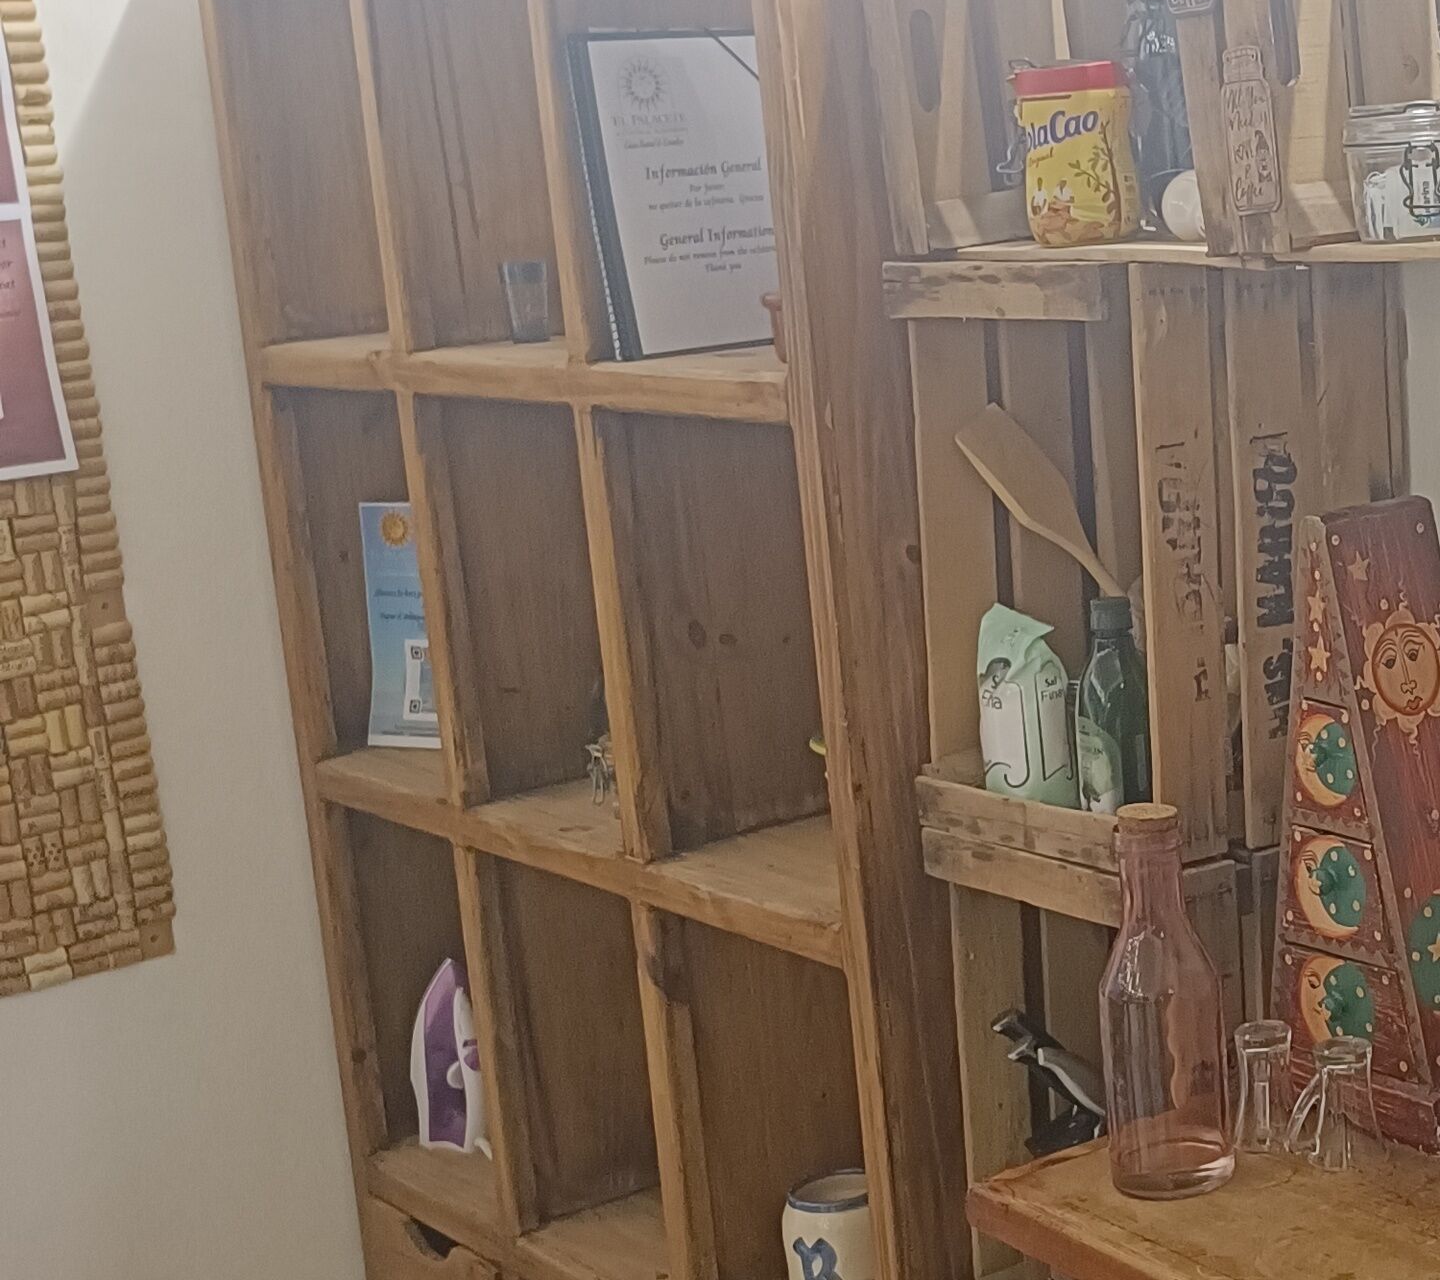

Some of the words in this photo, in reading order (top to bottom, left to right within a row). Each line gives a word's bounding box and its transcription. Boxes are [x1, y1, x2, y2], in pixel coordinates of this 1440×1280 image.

[645, 162, 717, 185] Información
[720, 156, 762, 178] General
[1235, 176, 1264, 205] Coffee
[659, 227, 704, 251] General
[706, 224, 774, 250] Information
[1044, 675, 1058, 688] Sal
